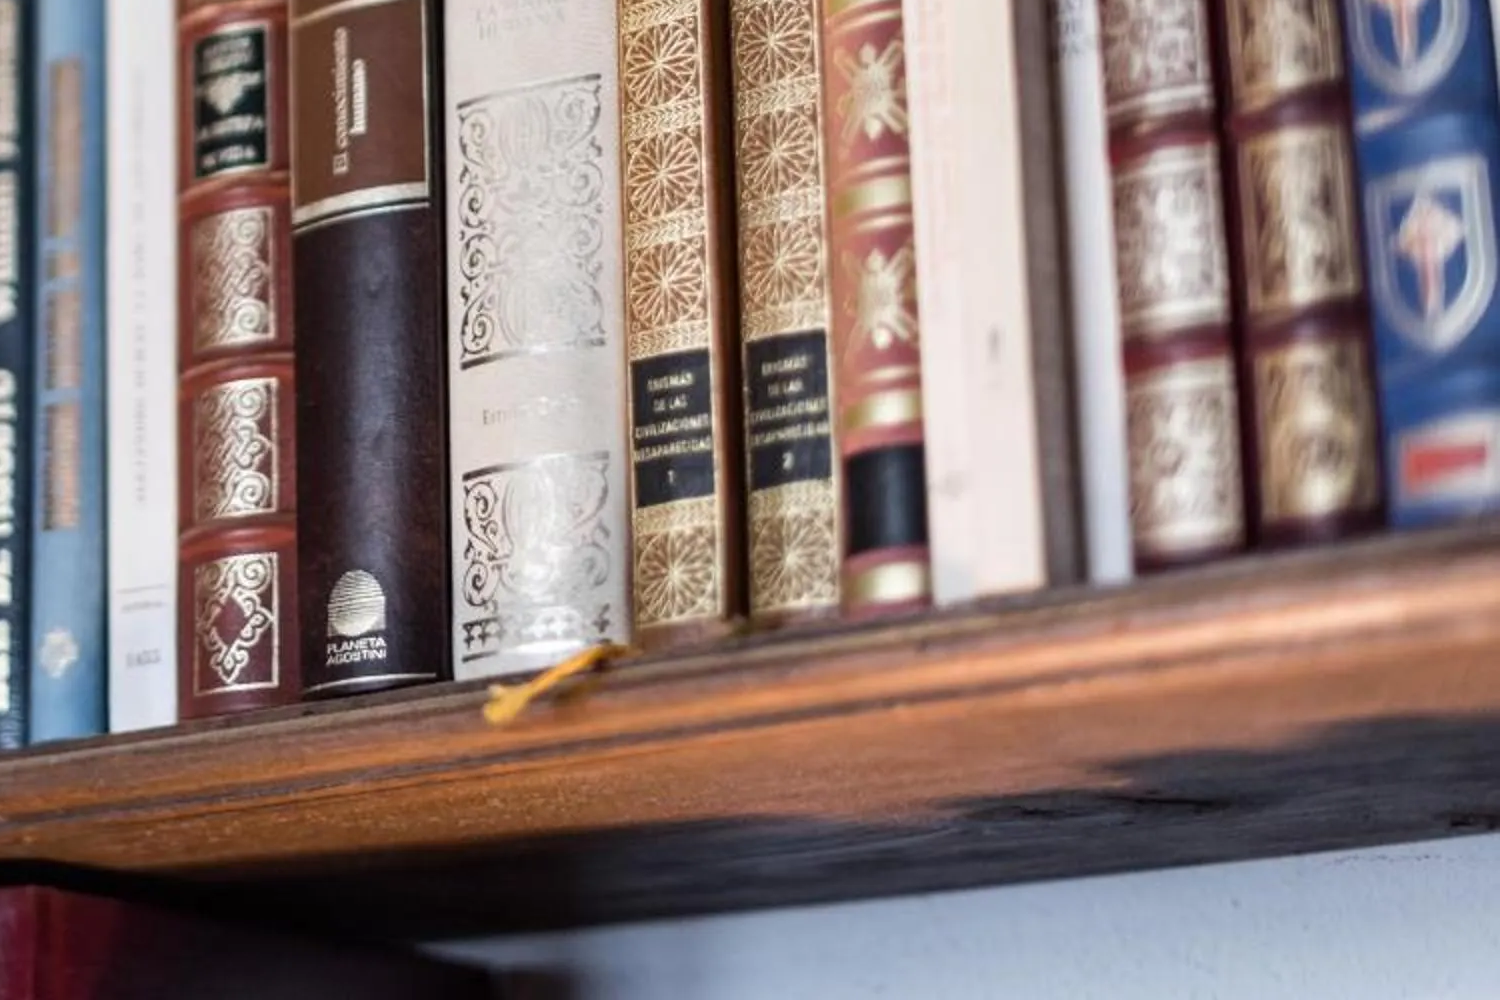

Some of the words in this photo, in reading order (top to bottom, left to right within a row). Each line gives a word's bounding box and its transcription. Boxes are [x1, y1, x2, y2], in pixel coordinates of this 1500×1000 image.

[333, 27, 348, 149] conocimiento
[350, 58, 367, 136] humano
[333, 154, 349, 175] El
[653, 398, 666, 412] DE
[669, 394, 687, 411] LAS
[782, 451, 795, 471] 2
[668, 470, 676, 484] 1
[327, 637, 387, 655] PLANETA
[325, 649, 387, 667] AGOSTINI
